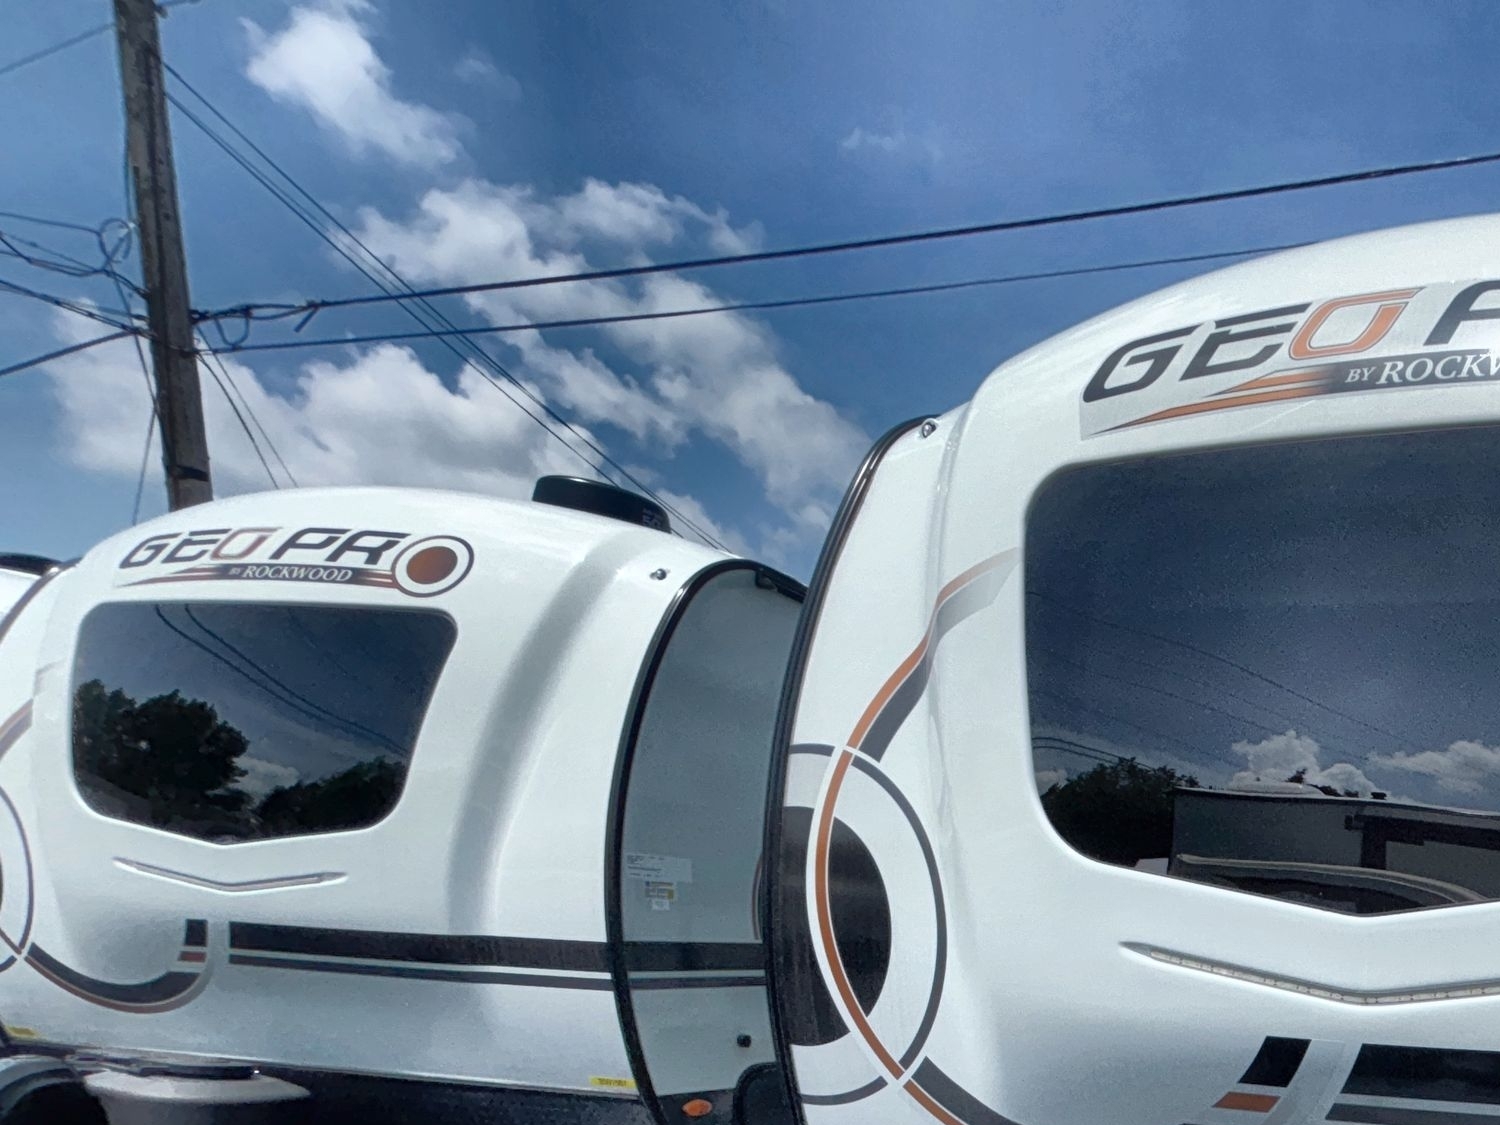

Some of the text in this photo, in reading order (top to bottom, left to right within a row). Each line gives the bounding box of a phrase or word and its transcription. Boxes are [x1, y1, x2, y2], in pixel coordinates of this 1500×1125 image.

[1082, 286, 1426, 403] GEO
[1344, 365, 1377, 384] BY
[118, 527, 283, 569] GEO
[242, 565, 353, 582] ROCKWOOD
